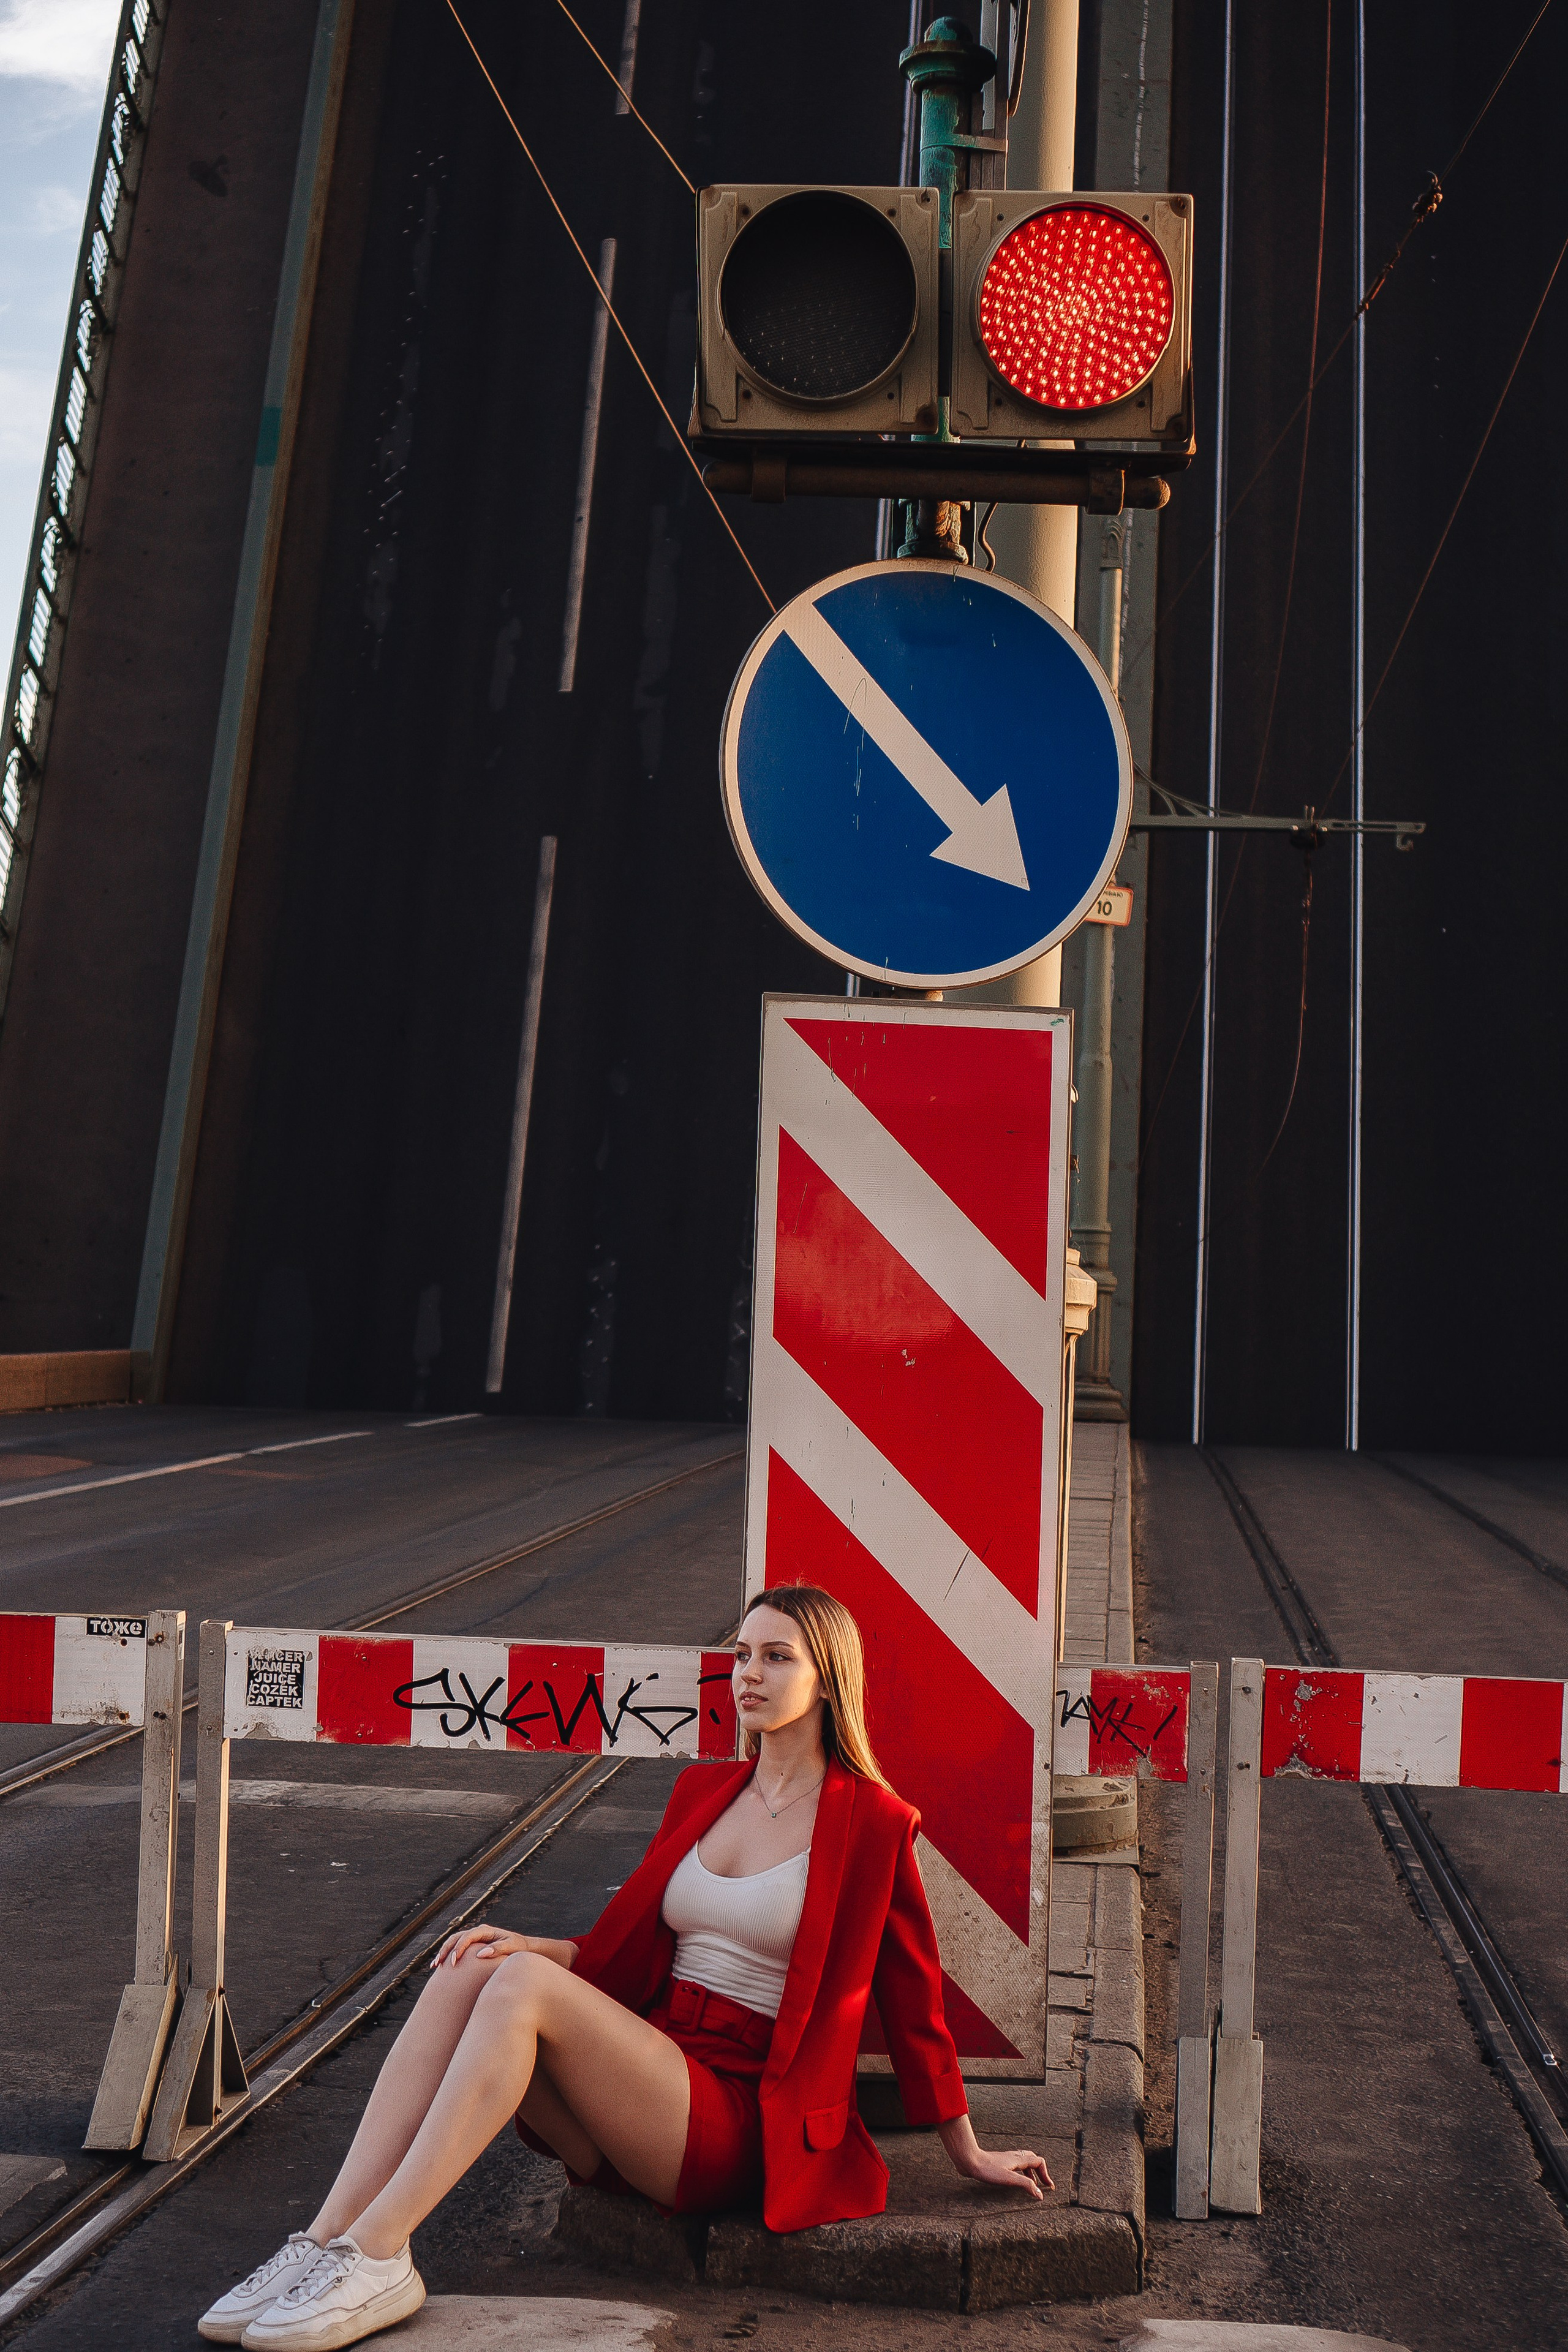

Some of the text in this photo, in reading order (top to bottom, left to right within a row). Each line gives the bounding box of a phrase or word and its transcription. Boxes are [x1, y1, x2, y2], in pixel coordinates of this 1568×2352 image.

[1097, 900, 1112, 916] 10
[254, 1673, 296, 1684] JUICE
[251, 1683, 298, 1697] COZEK
[247, 1695, 303, 1708] CAPTEK
